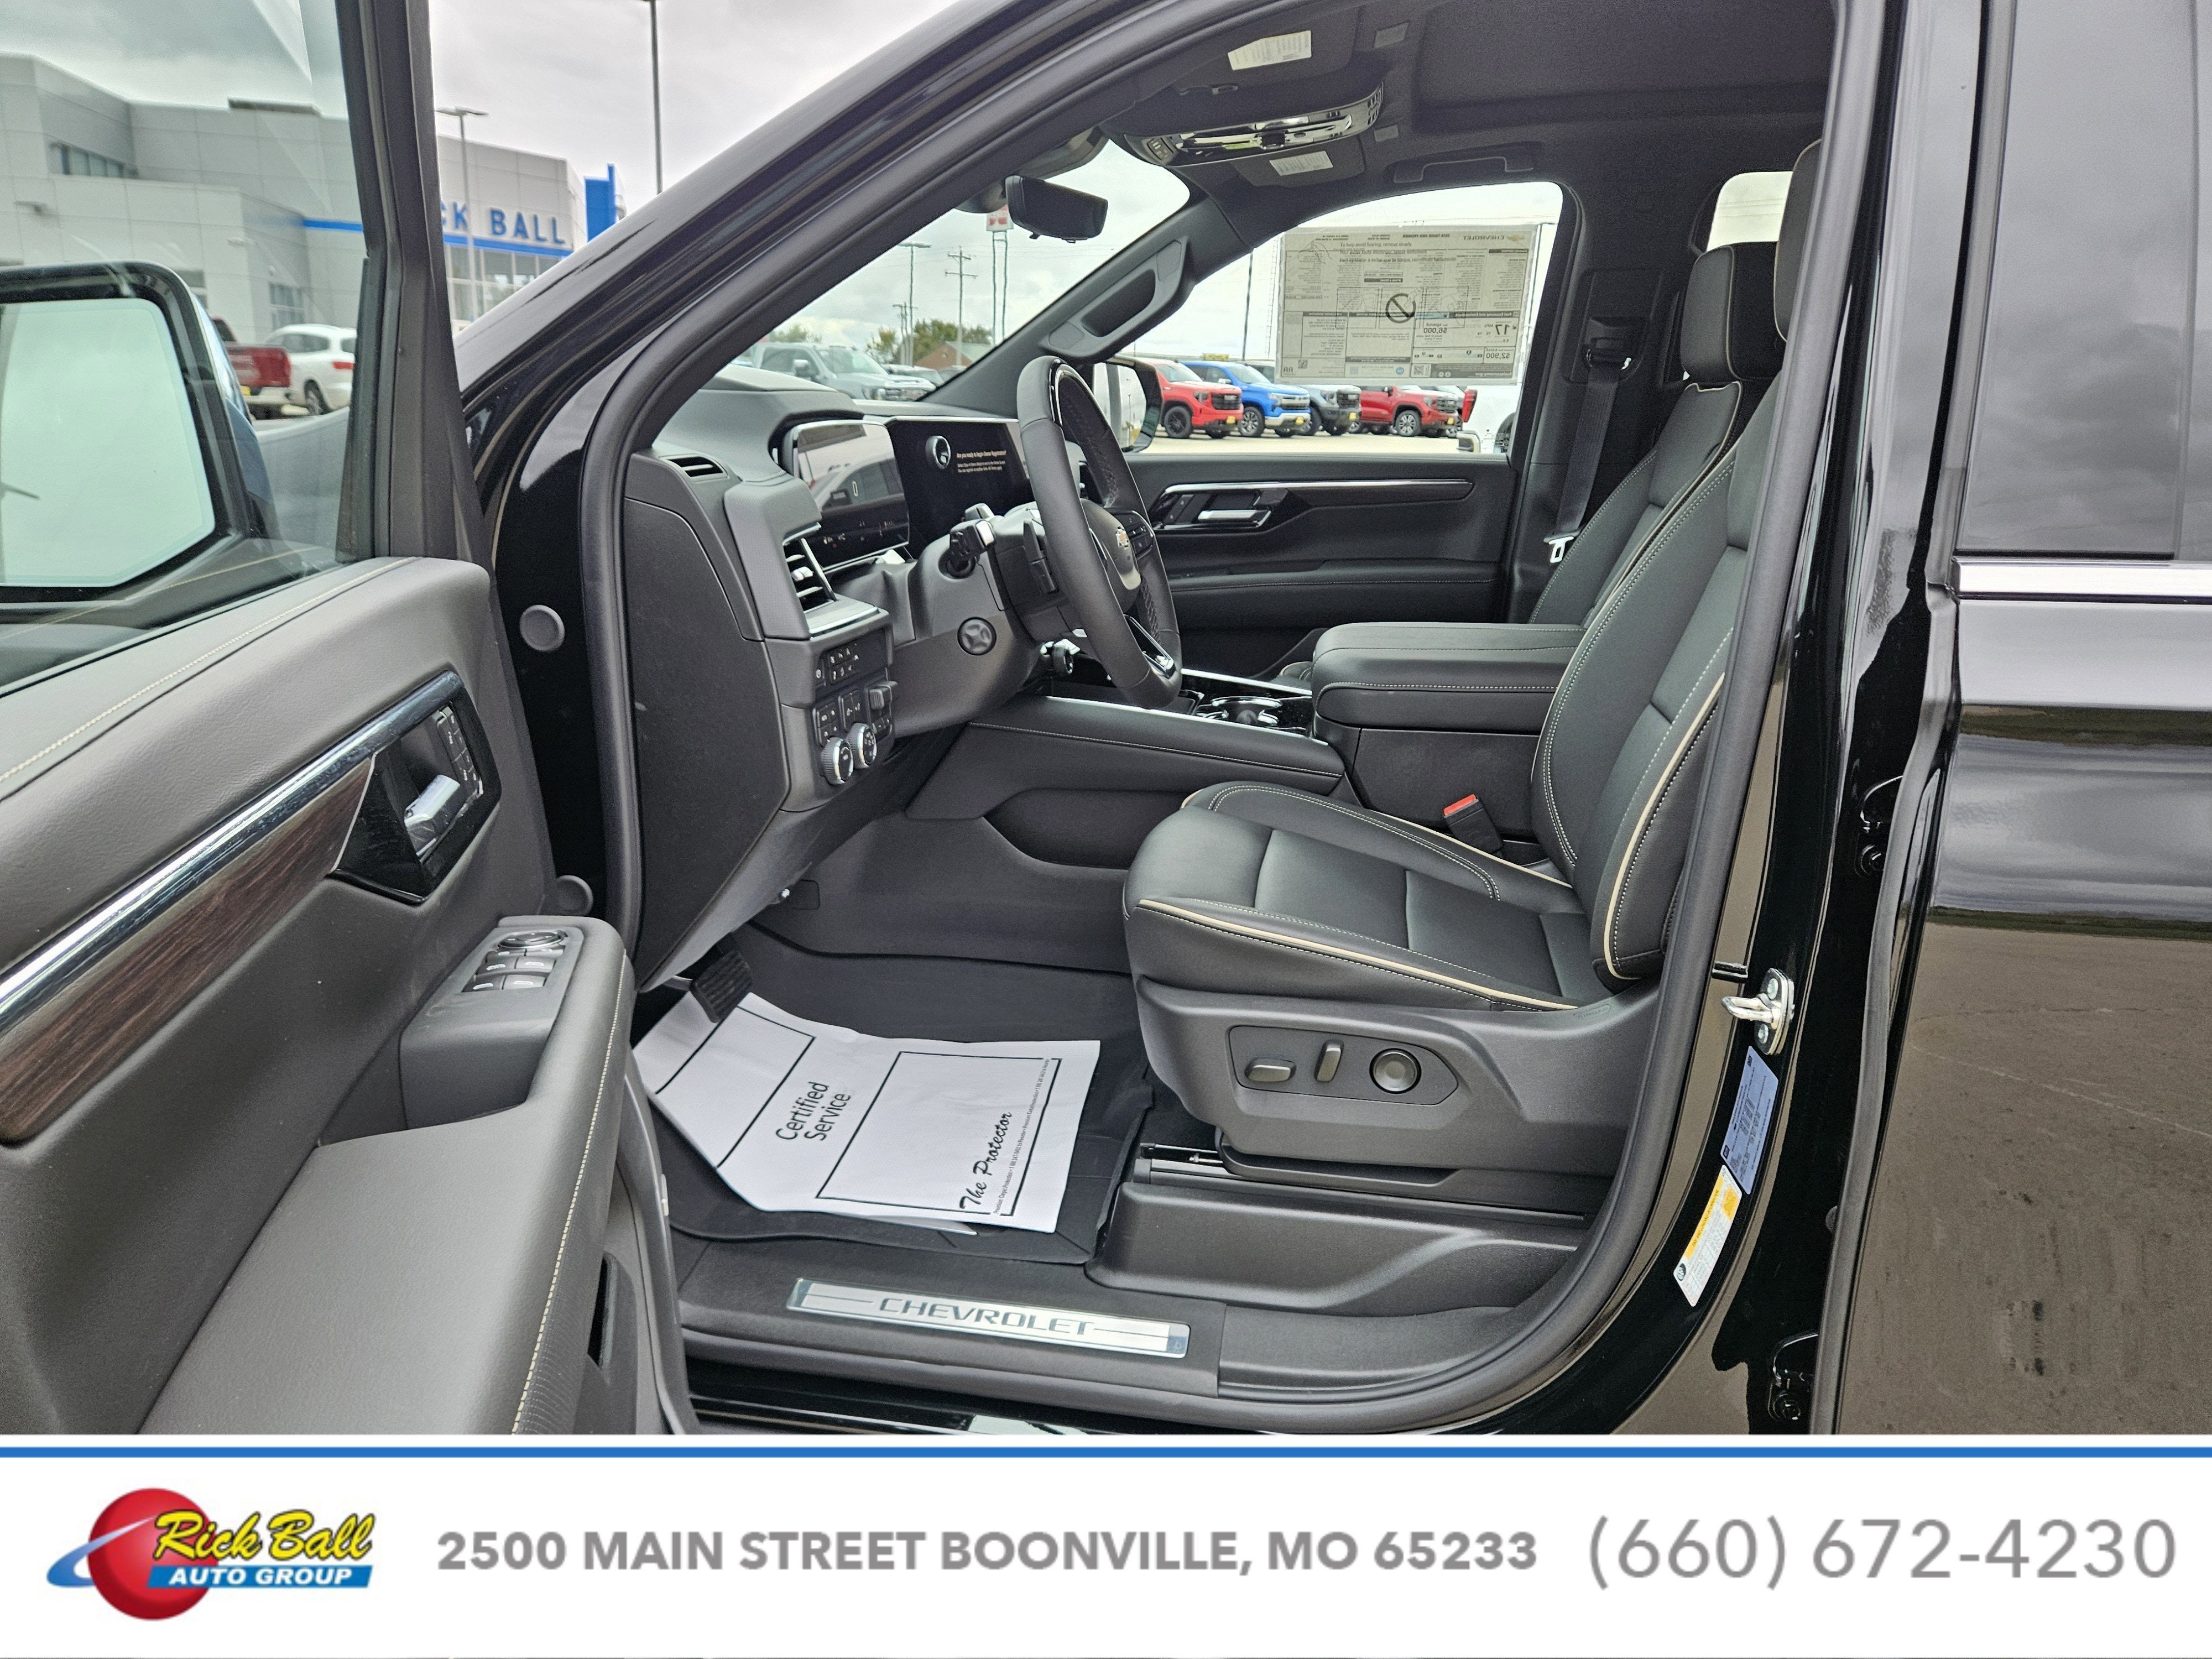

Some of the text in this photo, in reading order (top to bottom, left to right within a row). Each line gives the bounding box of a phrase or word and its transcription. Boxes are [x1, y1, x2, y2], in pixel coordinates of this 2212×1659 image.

[490, 208, 566, 244] BALL
[776, 1082, 830, 1140] Certified
[804, 1093, 852, 1141] Service
[959, 1112, 1012, 1209] The Protector
[879, 1297, 1095, 1335] CHEVROLET
